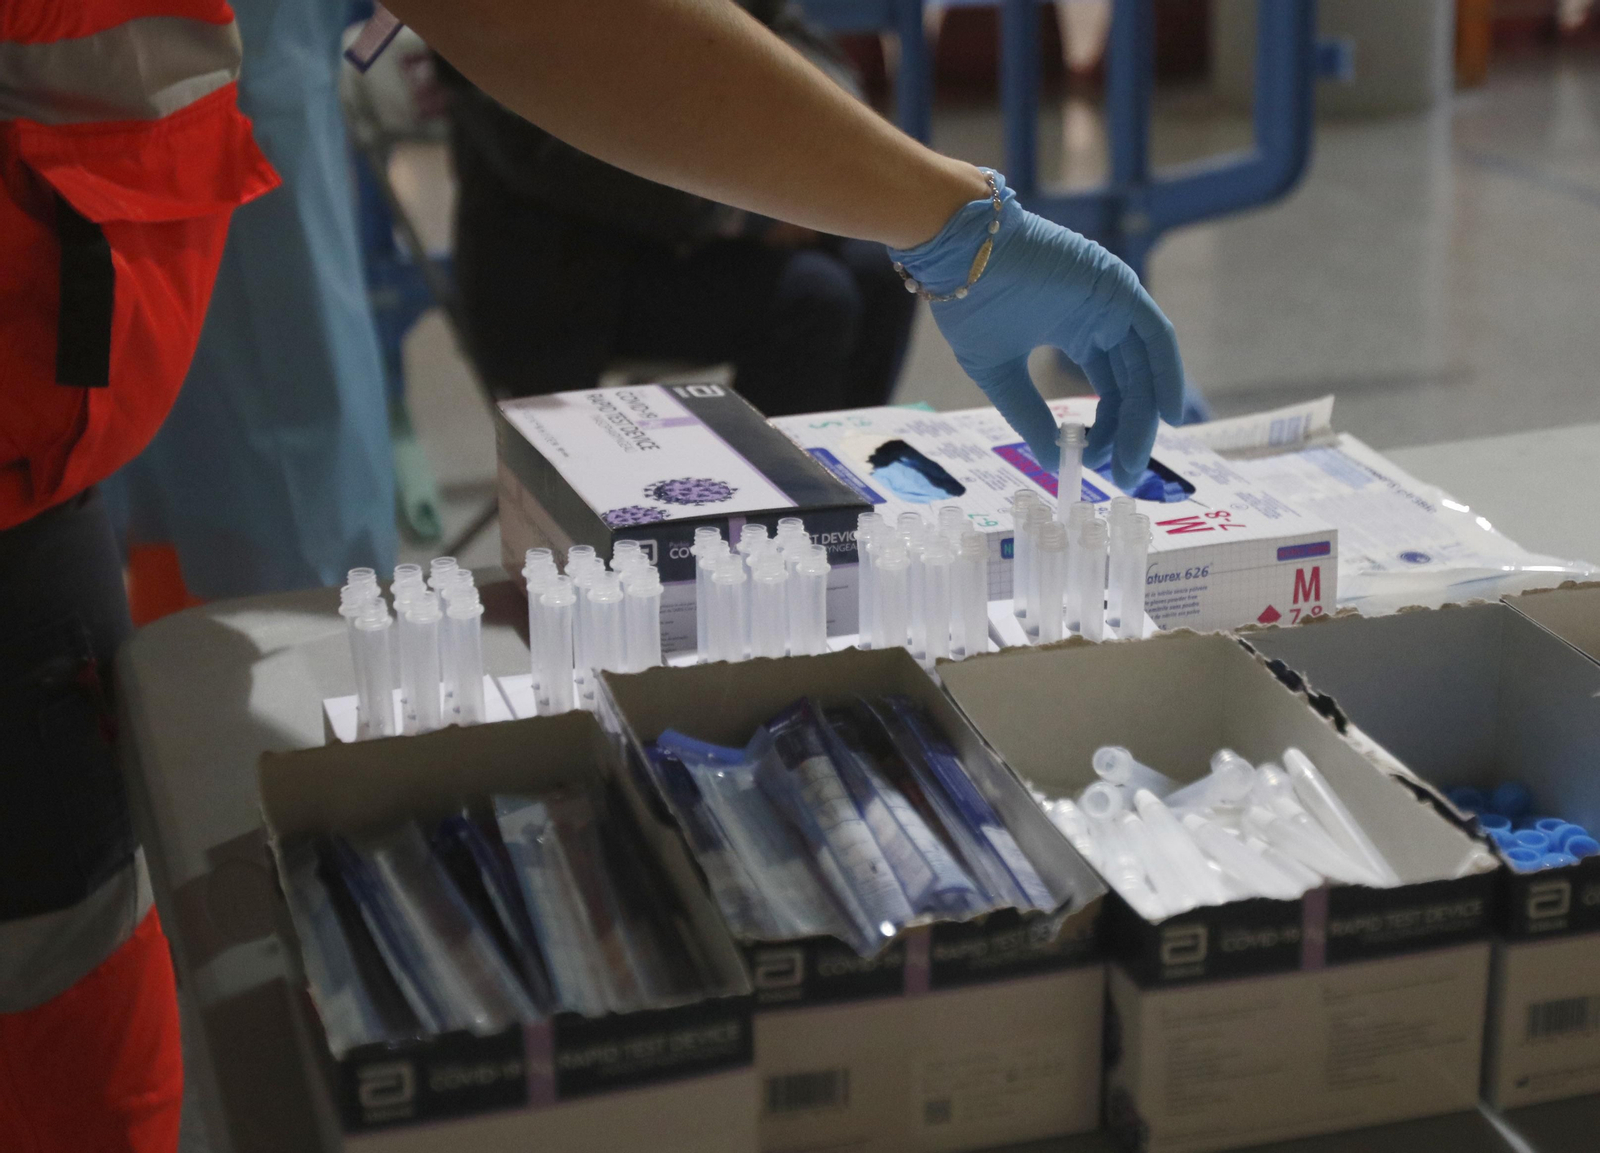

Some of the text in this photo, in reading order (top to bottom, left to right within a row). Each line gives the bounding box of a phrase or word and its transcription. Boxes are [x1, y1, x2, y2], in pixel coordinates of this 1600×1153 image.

[620, 426, 661, 451] DEVICE
[1154, 515, 1217, 536] M
[1204, 510, 1247, 532] 7-8
[821, 531, 857, 545] DEVIC
[1146, 565, 1209, 585] aturex 626
[1292, 566, 1321, 605] M
